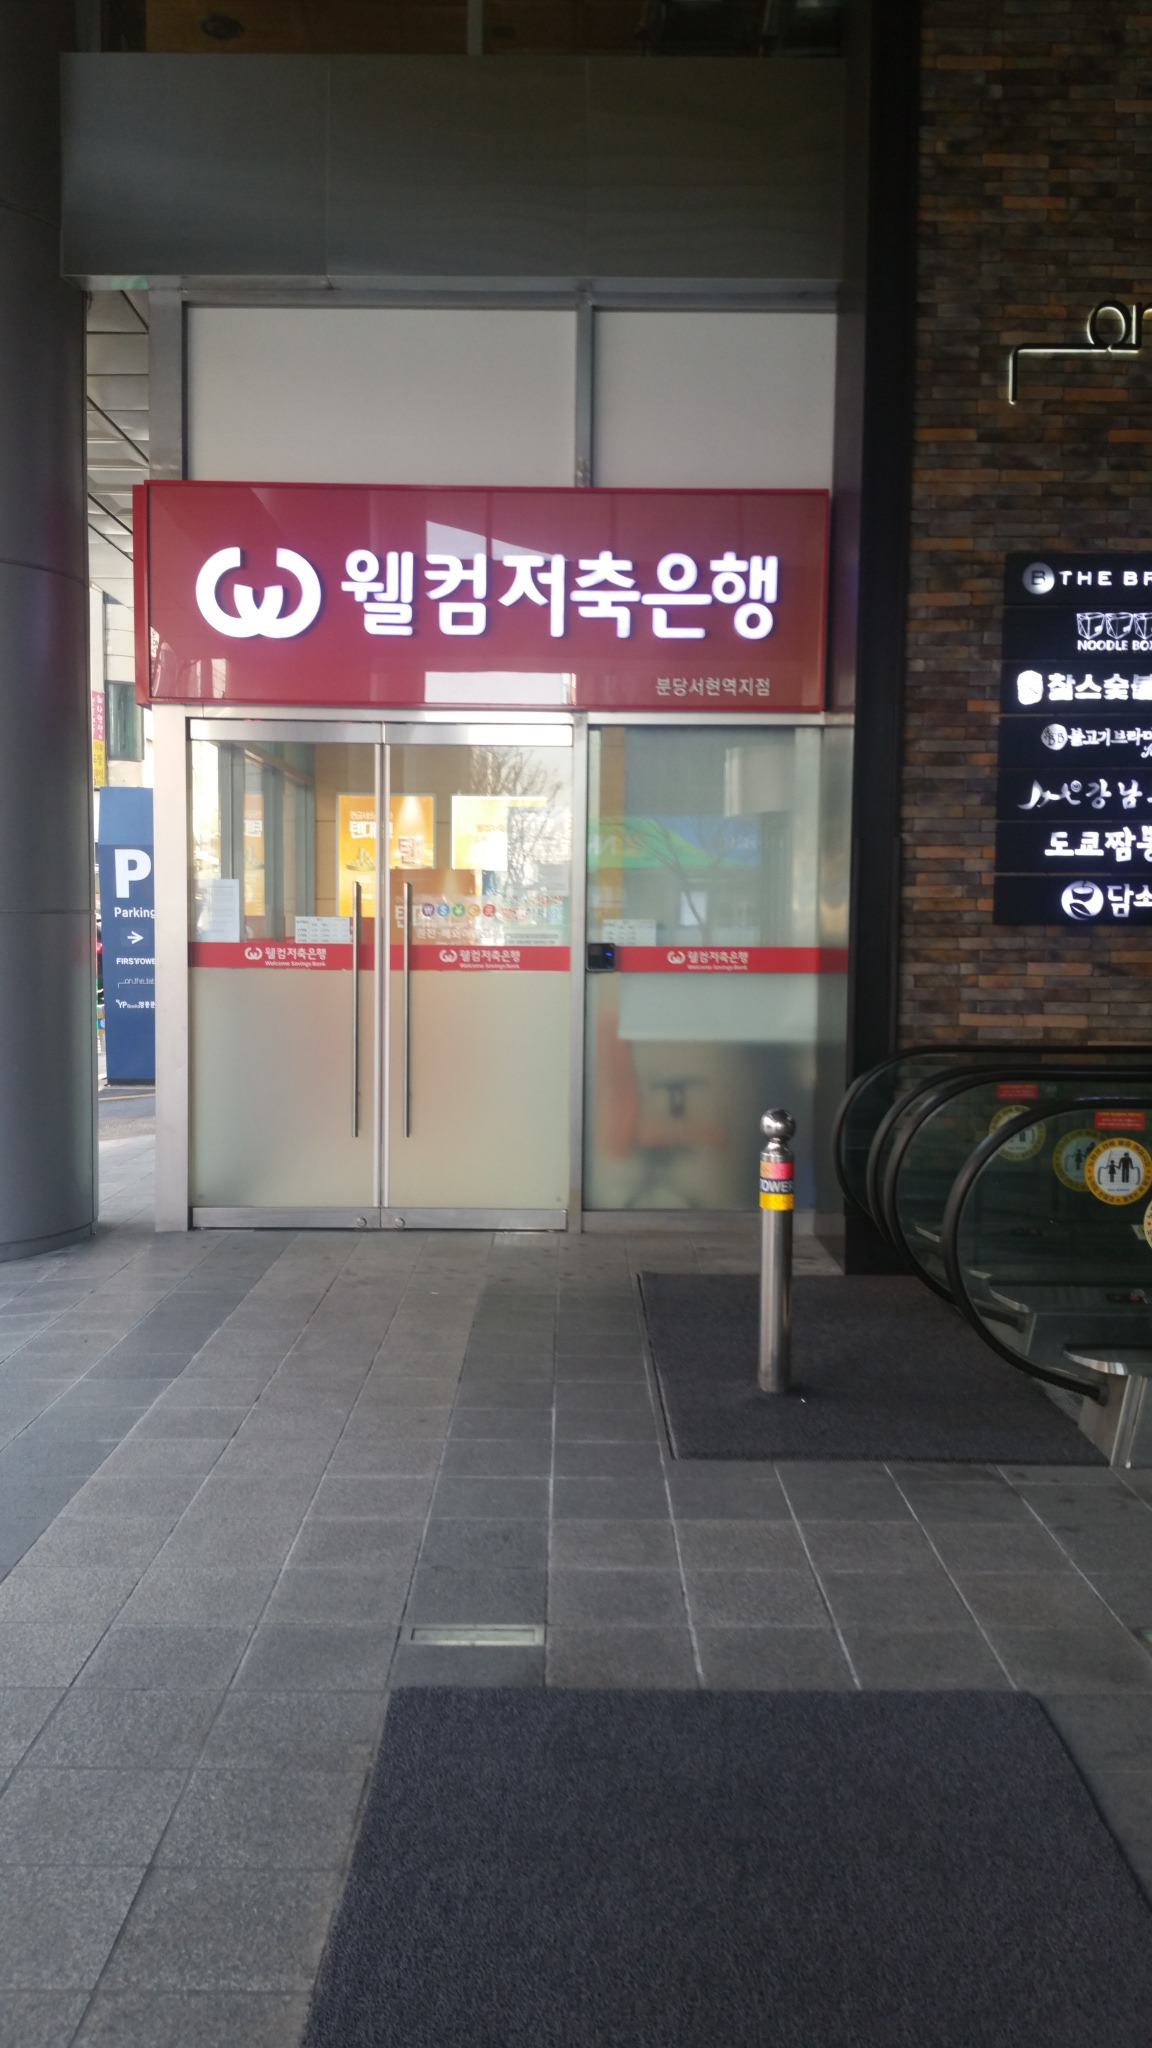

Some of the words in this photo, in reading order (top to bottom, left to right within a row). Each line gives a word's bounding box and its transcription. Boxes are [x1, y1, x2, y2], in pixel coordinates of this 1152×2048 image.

[1059, 570, 1112, 586] THE
[341, 549, 778, 640] 웰컴저축은행
[1077, 640, 1128, 651] NOODLE
[656, 677, 770, 697] 분당서현역지점
[114, 848, 152, 899] P
[114, 906, 156, 919] Parking
[265, 947, 327, 961] 웰컴저축은행
